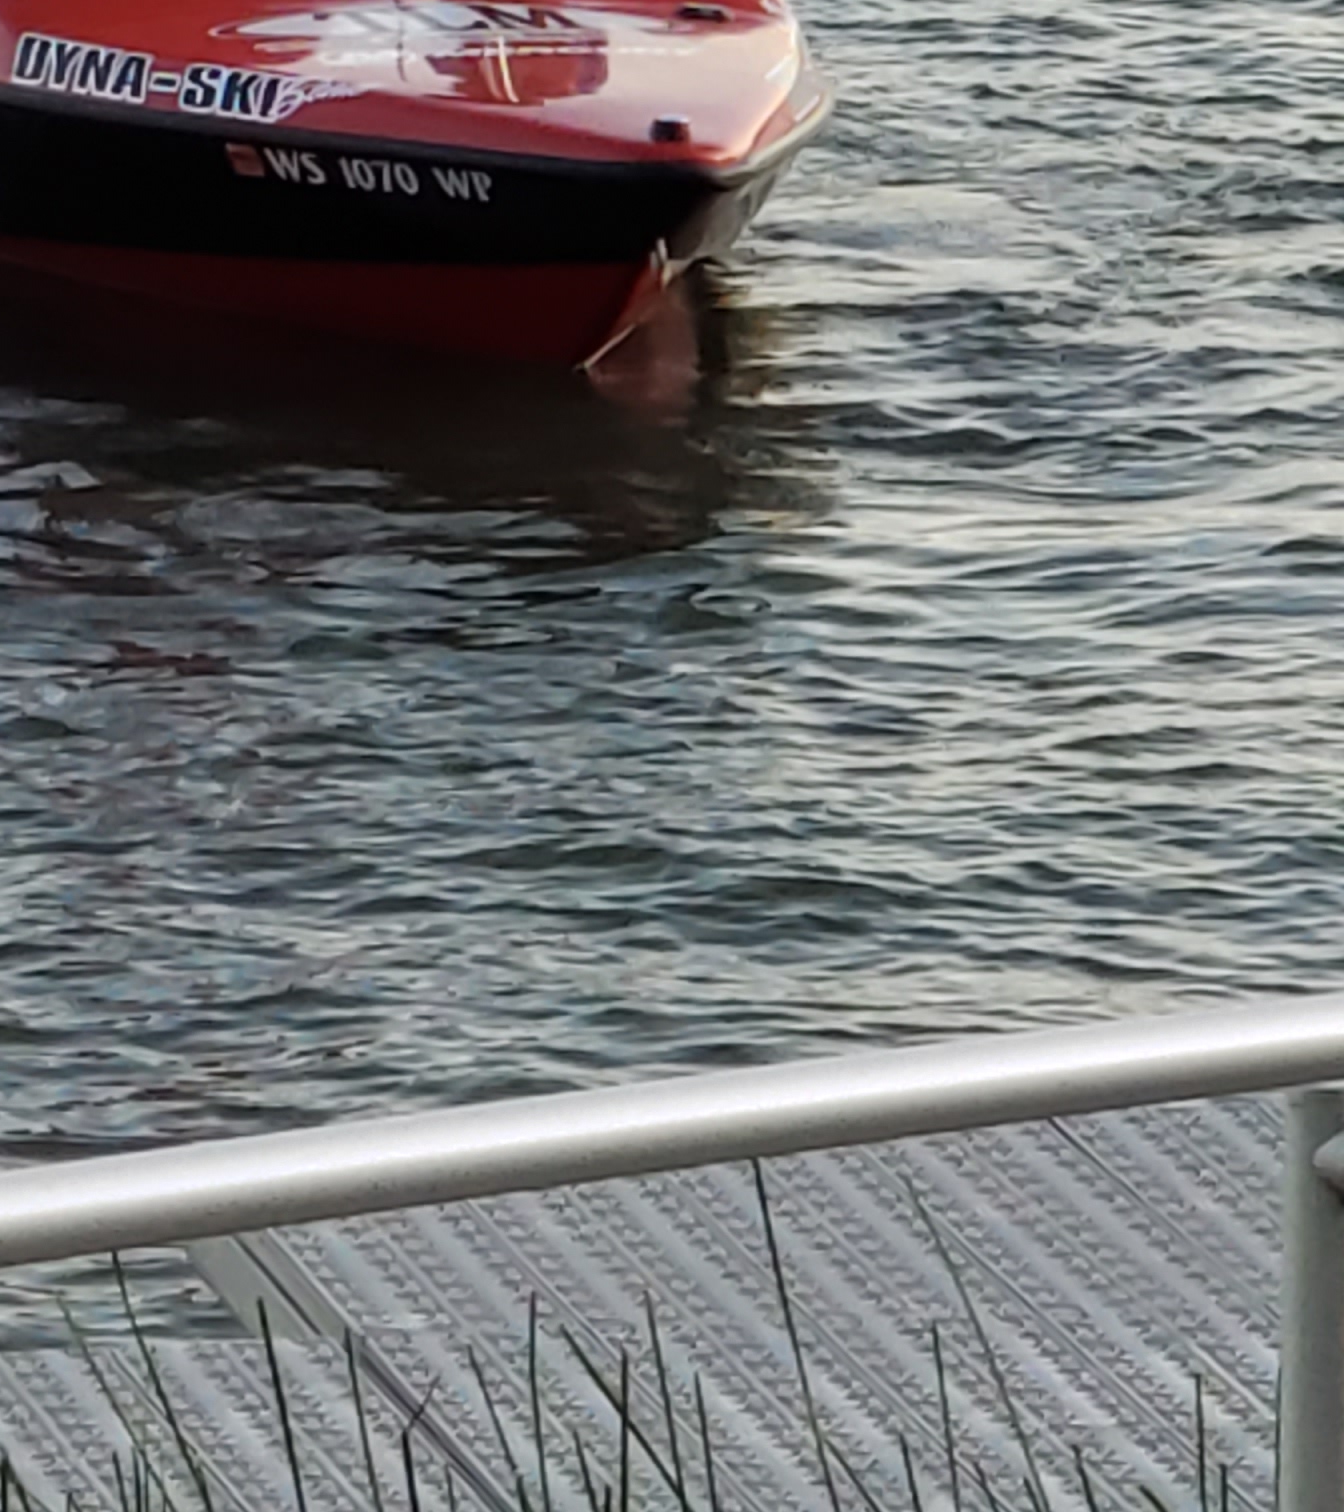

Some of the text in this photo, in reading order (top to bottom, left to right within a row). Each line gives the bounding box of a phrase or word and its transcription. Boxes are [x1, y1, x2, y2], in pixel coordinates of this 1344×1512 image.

[11, 31, 280, 124] DYNA-SKI
[263, 146, 493, 202] WS 1070 WP
